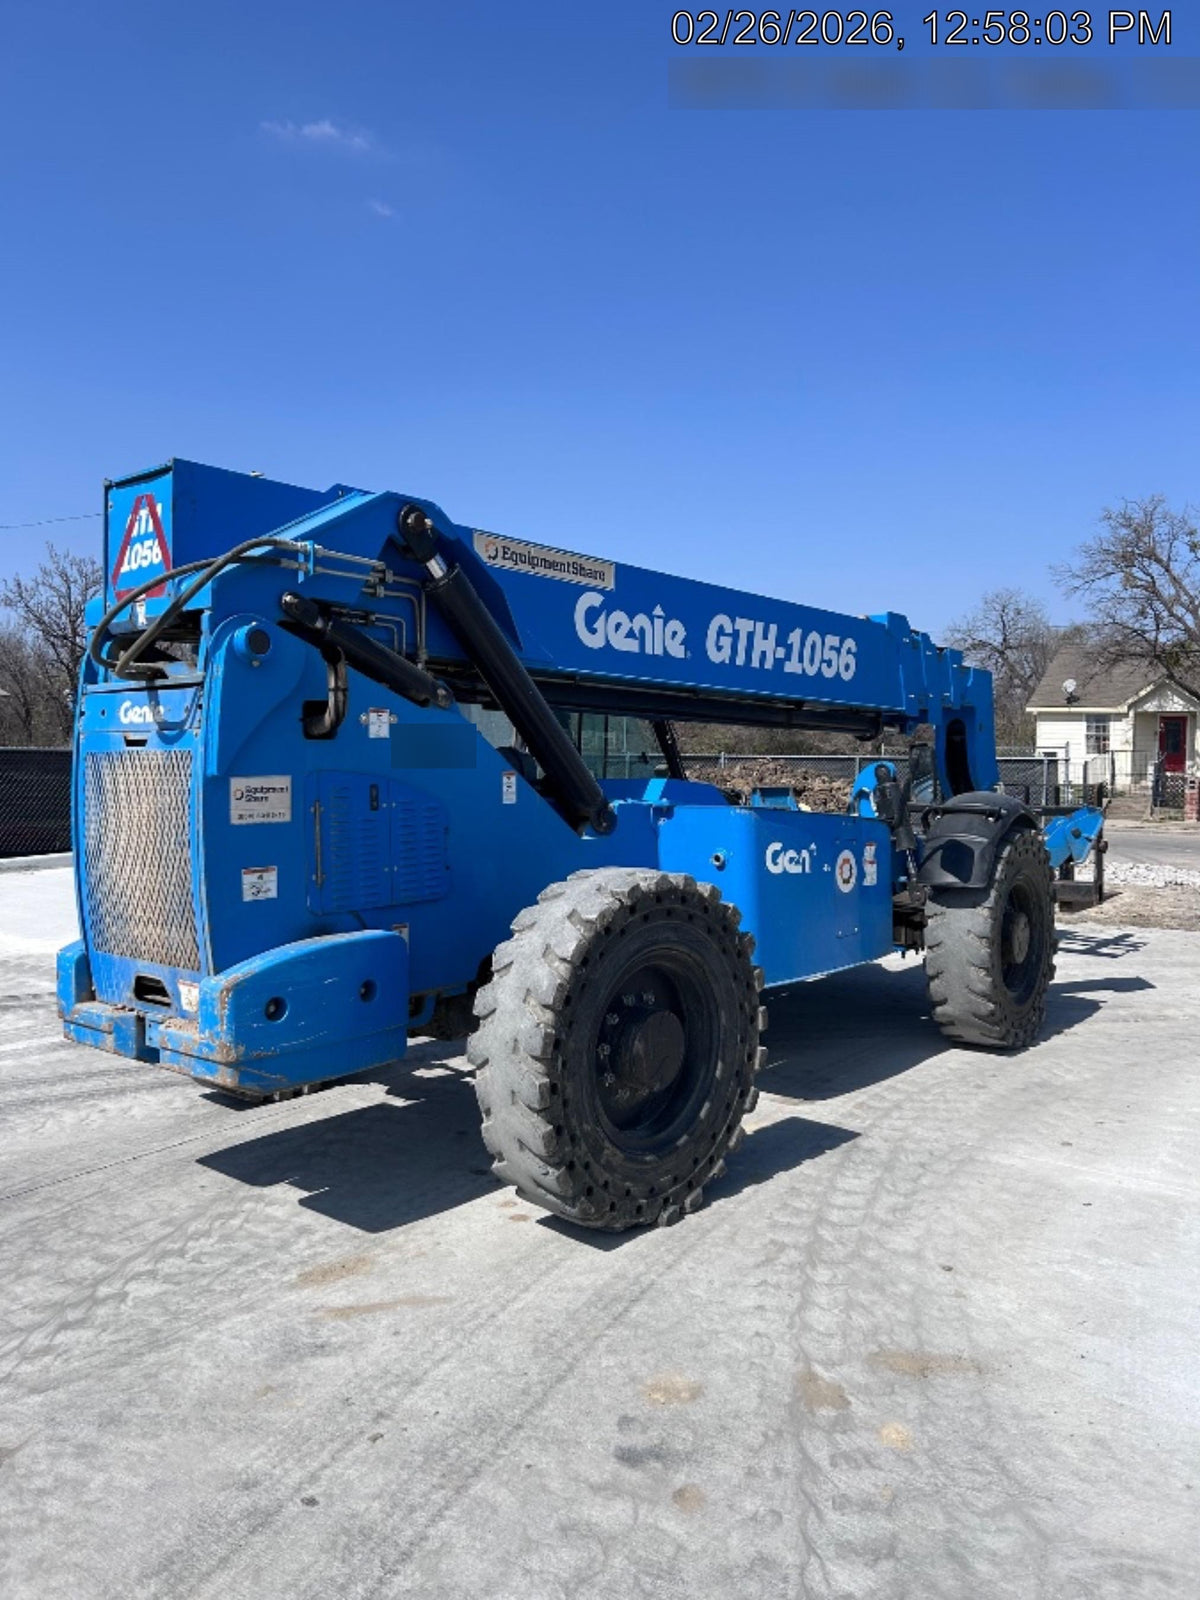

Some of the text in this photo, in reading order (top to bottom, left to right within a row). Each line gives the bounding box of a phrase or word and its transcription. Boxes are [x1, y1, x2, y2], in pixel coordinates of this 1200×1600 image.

[120, 538, 162, 573] 1056
[501, 545, 605, 582] EquipmentShare
[574, 591, 857, 681] Genie GTH-1056
